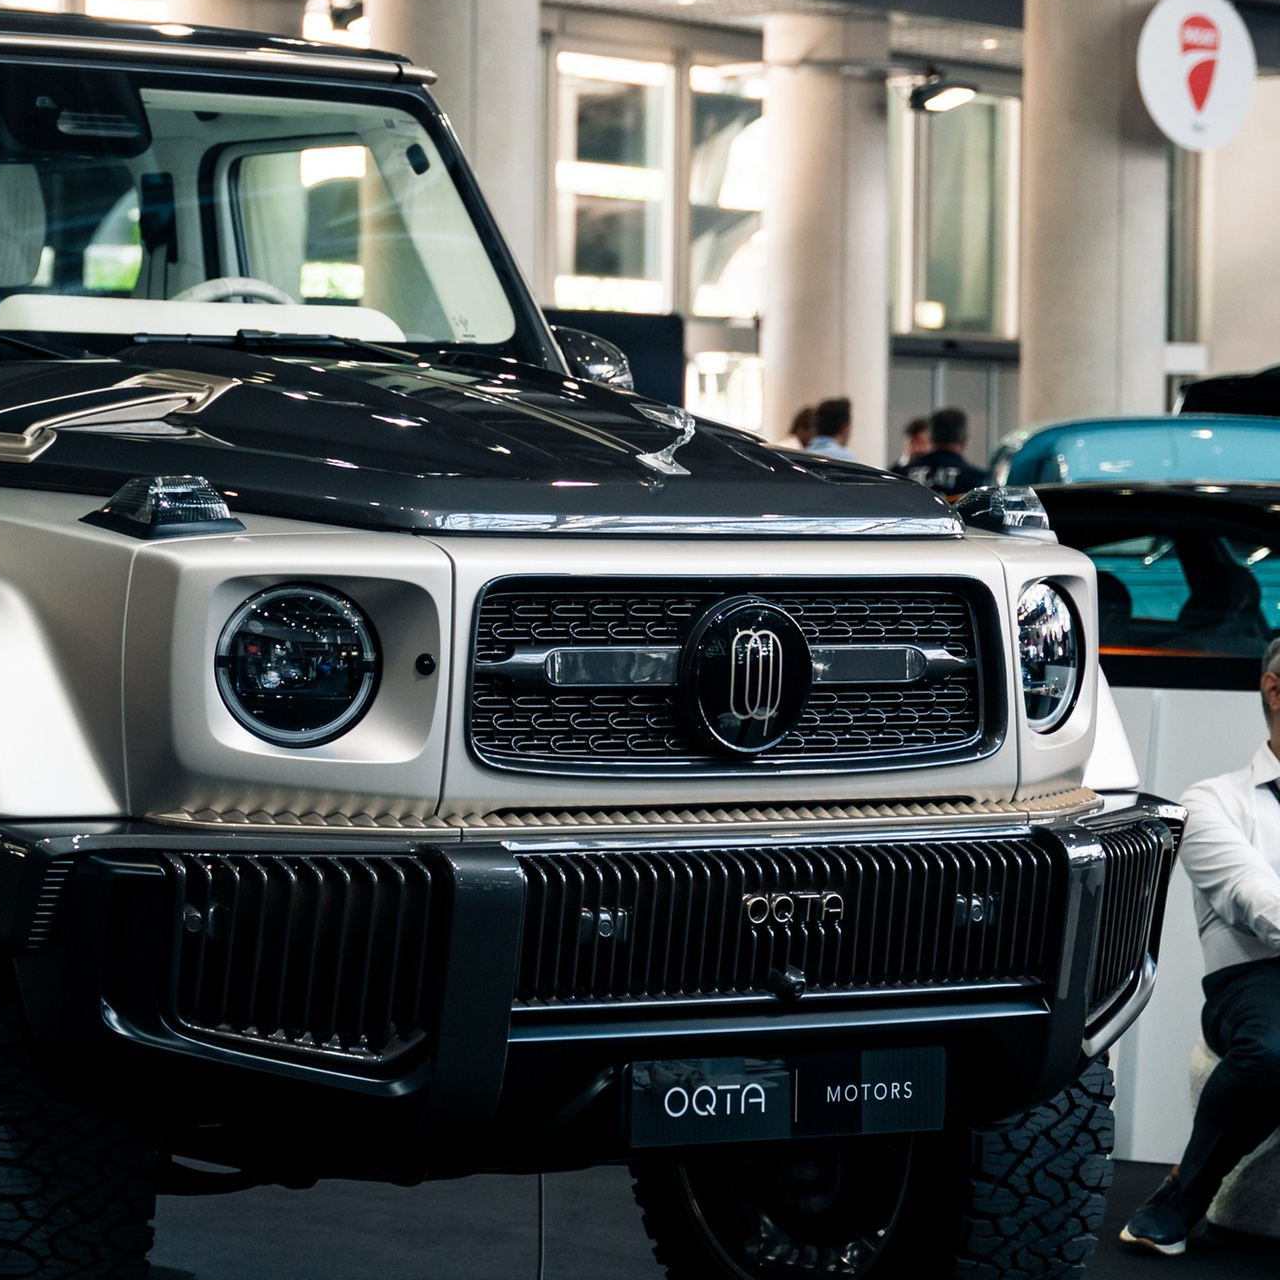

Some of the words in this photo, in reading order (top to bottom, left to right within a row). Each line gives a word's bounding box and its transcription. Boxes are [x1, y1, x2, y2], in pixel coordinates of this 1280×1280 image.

[742, 890, 844, 924] OQTA
[664, 1083, 766, 1118] OQTA
[826, 1081, 913, 1103] MOTORS
